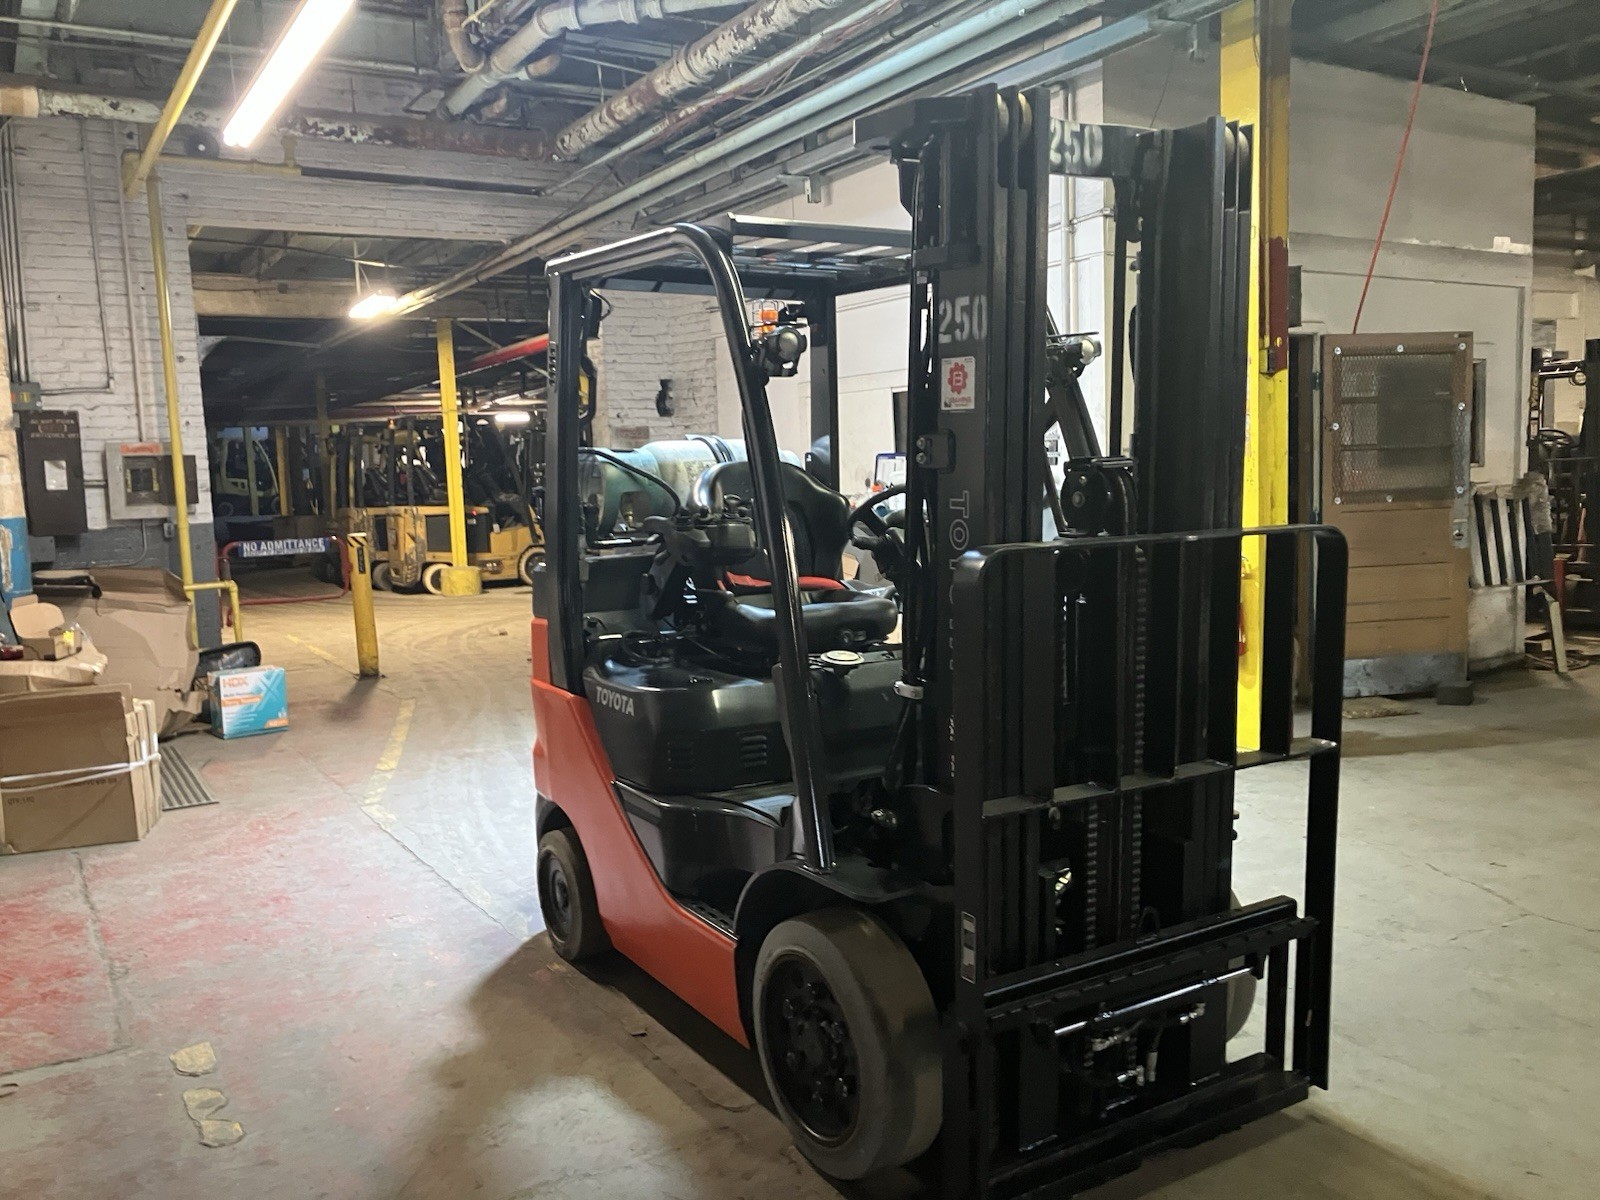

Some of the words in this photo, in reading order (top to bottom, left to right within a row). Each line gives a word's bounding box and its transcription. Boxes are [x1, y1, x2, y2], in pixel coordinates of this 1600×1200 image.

[1049, 118, 1103, 167] 250
[938, 295, 987, 343] 250
[243, 541, 257, 552] NO
[260, 537, 324, 551] ADMITTANCE
[596, 686, 635, 717] TOYOTA
